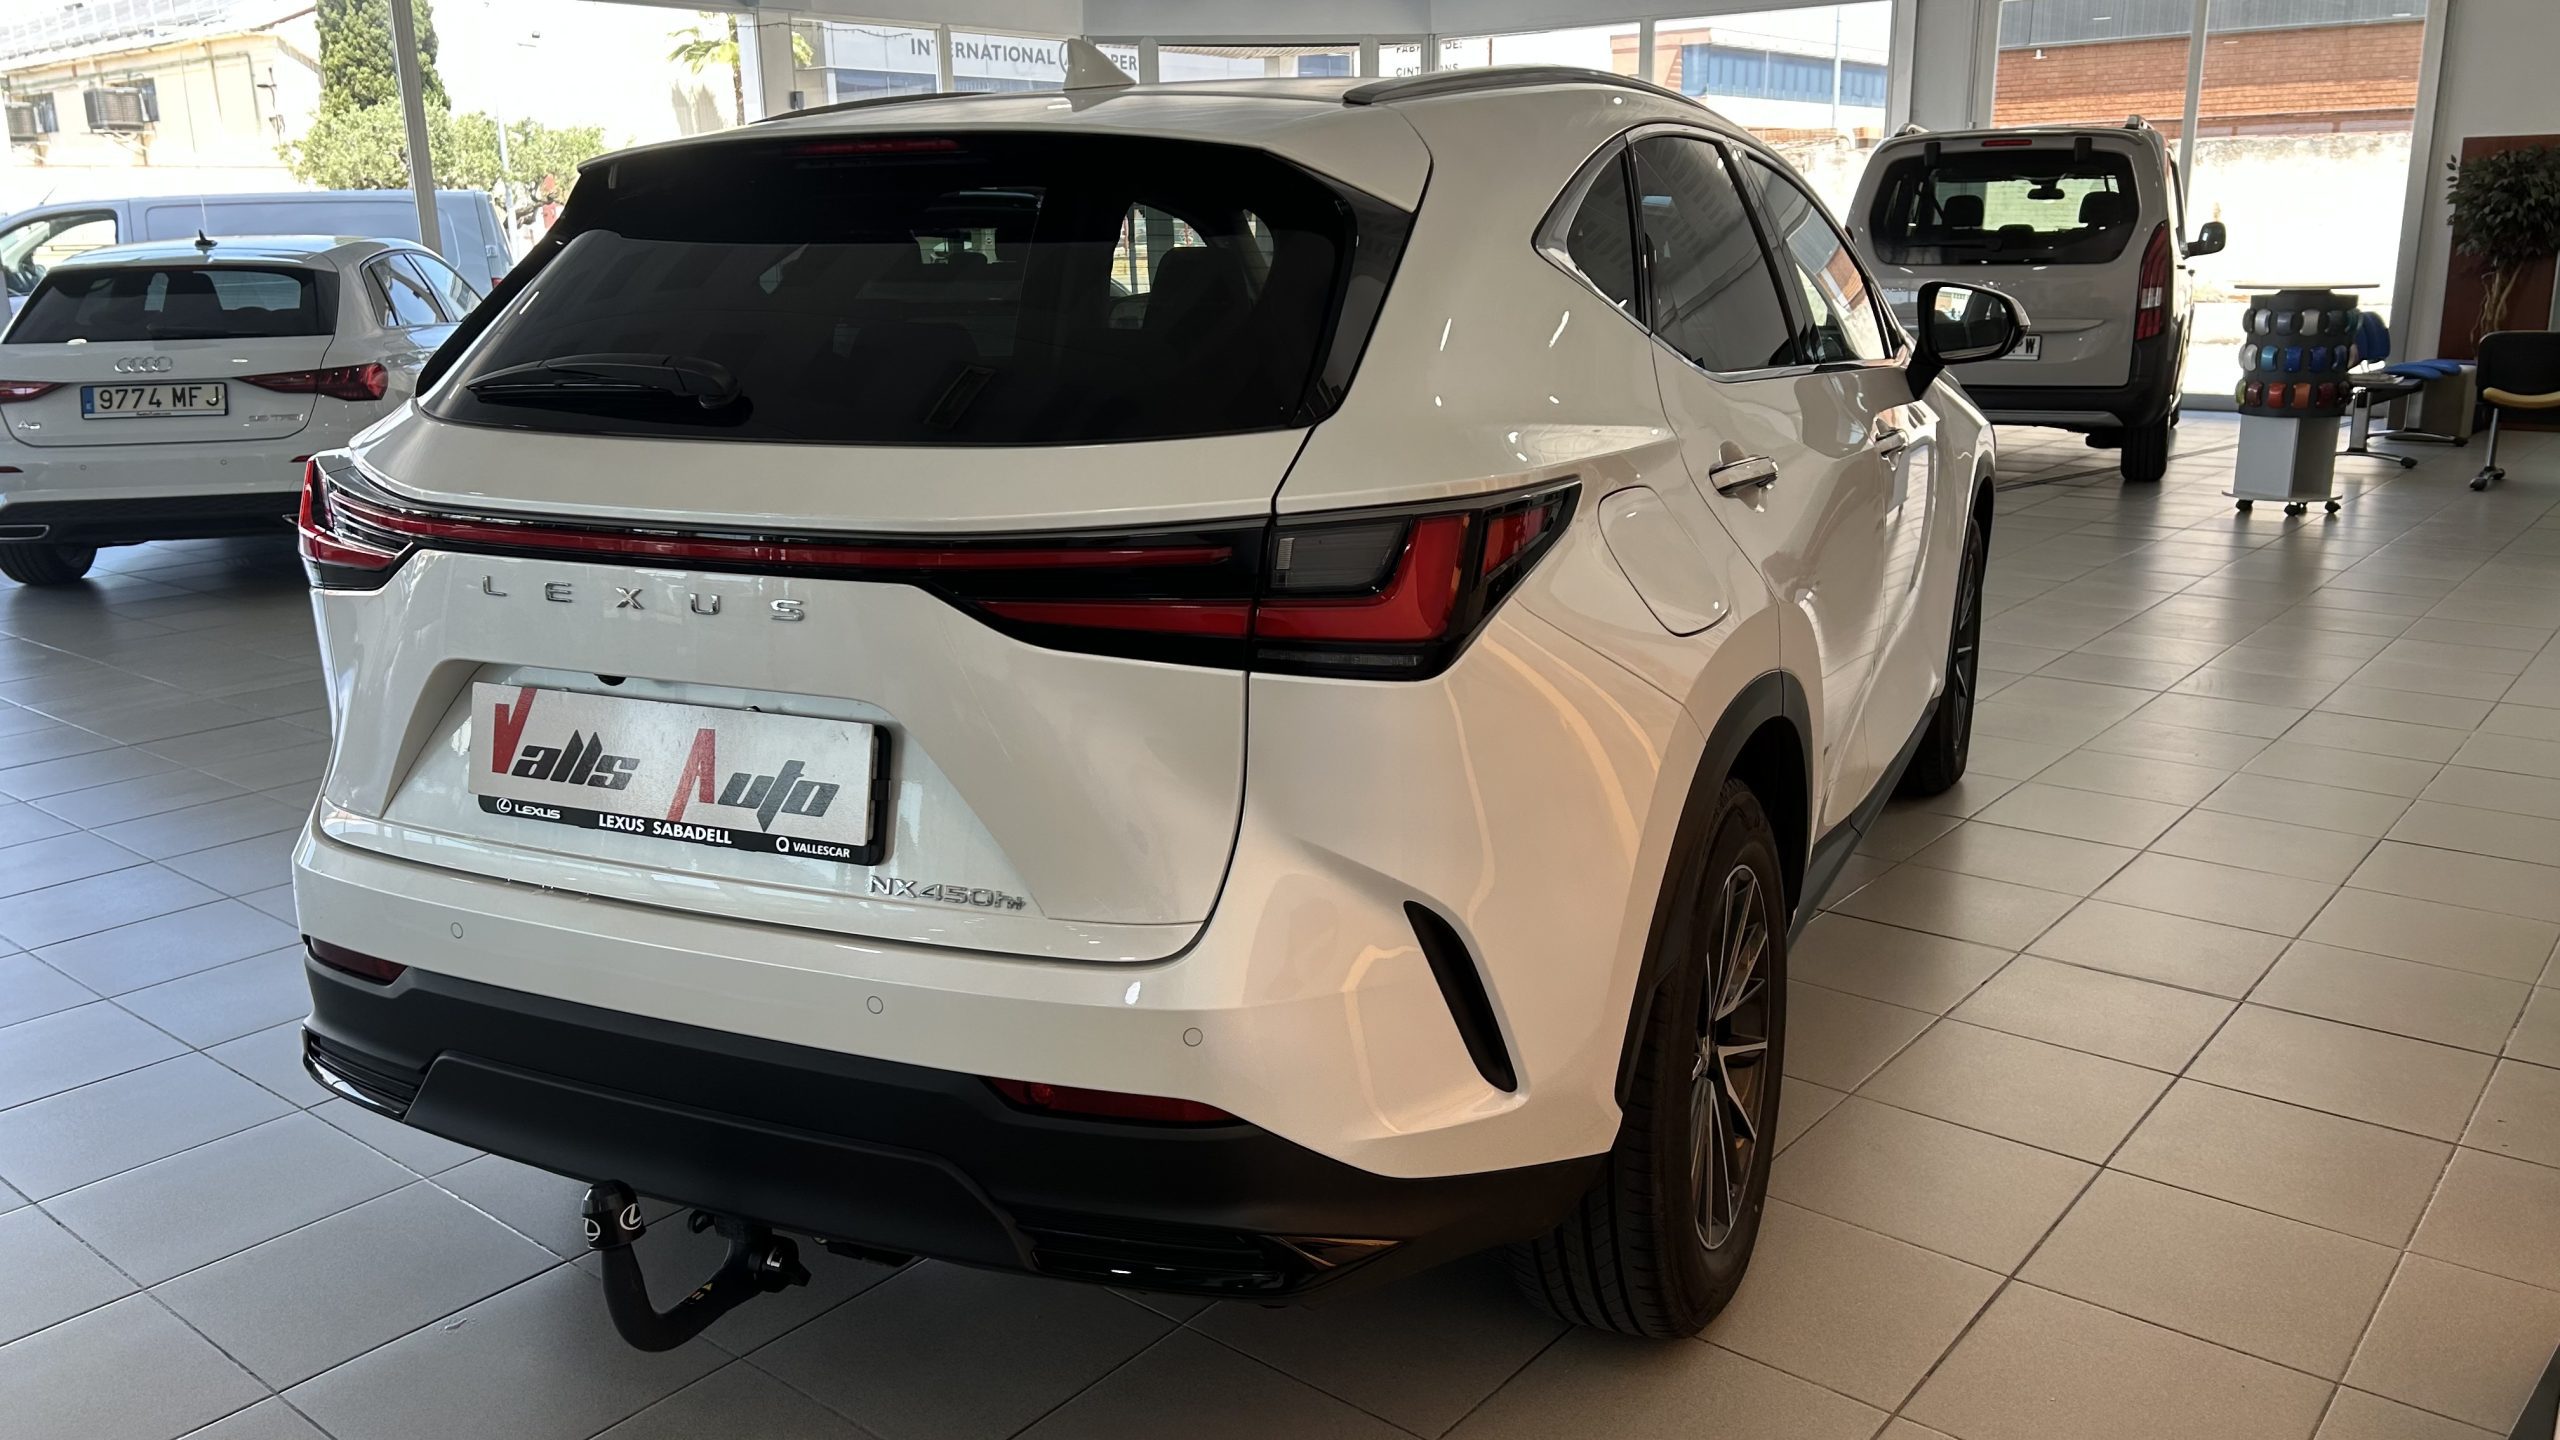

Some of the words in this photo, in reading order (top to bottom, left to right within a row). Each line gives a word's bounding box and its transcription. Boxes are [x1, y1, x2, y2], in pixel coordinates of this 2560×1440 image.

[911, 38, 1056, 65] INRNATIONAL
[1110, 54, 1138, 71] PER
[99, 388, 162, 410] 9774
[172, 386, 219, 408] MFJ
[482, 575, 805, 622] LEXUS
[492, 687, 641, 791] Valls
[666, 727, 840, 833] Auto
[514, 803, 561, 820] LEXUS
[598, 813, 645, 833] LEXUS
[652, 820, 733, 845] SABADELL
[792, 841, 850, 859] VALLESCAR
